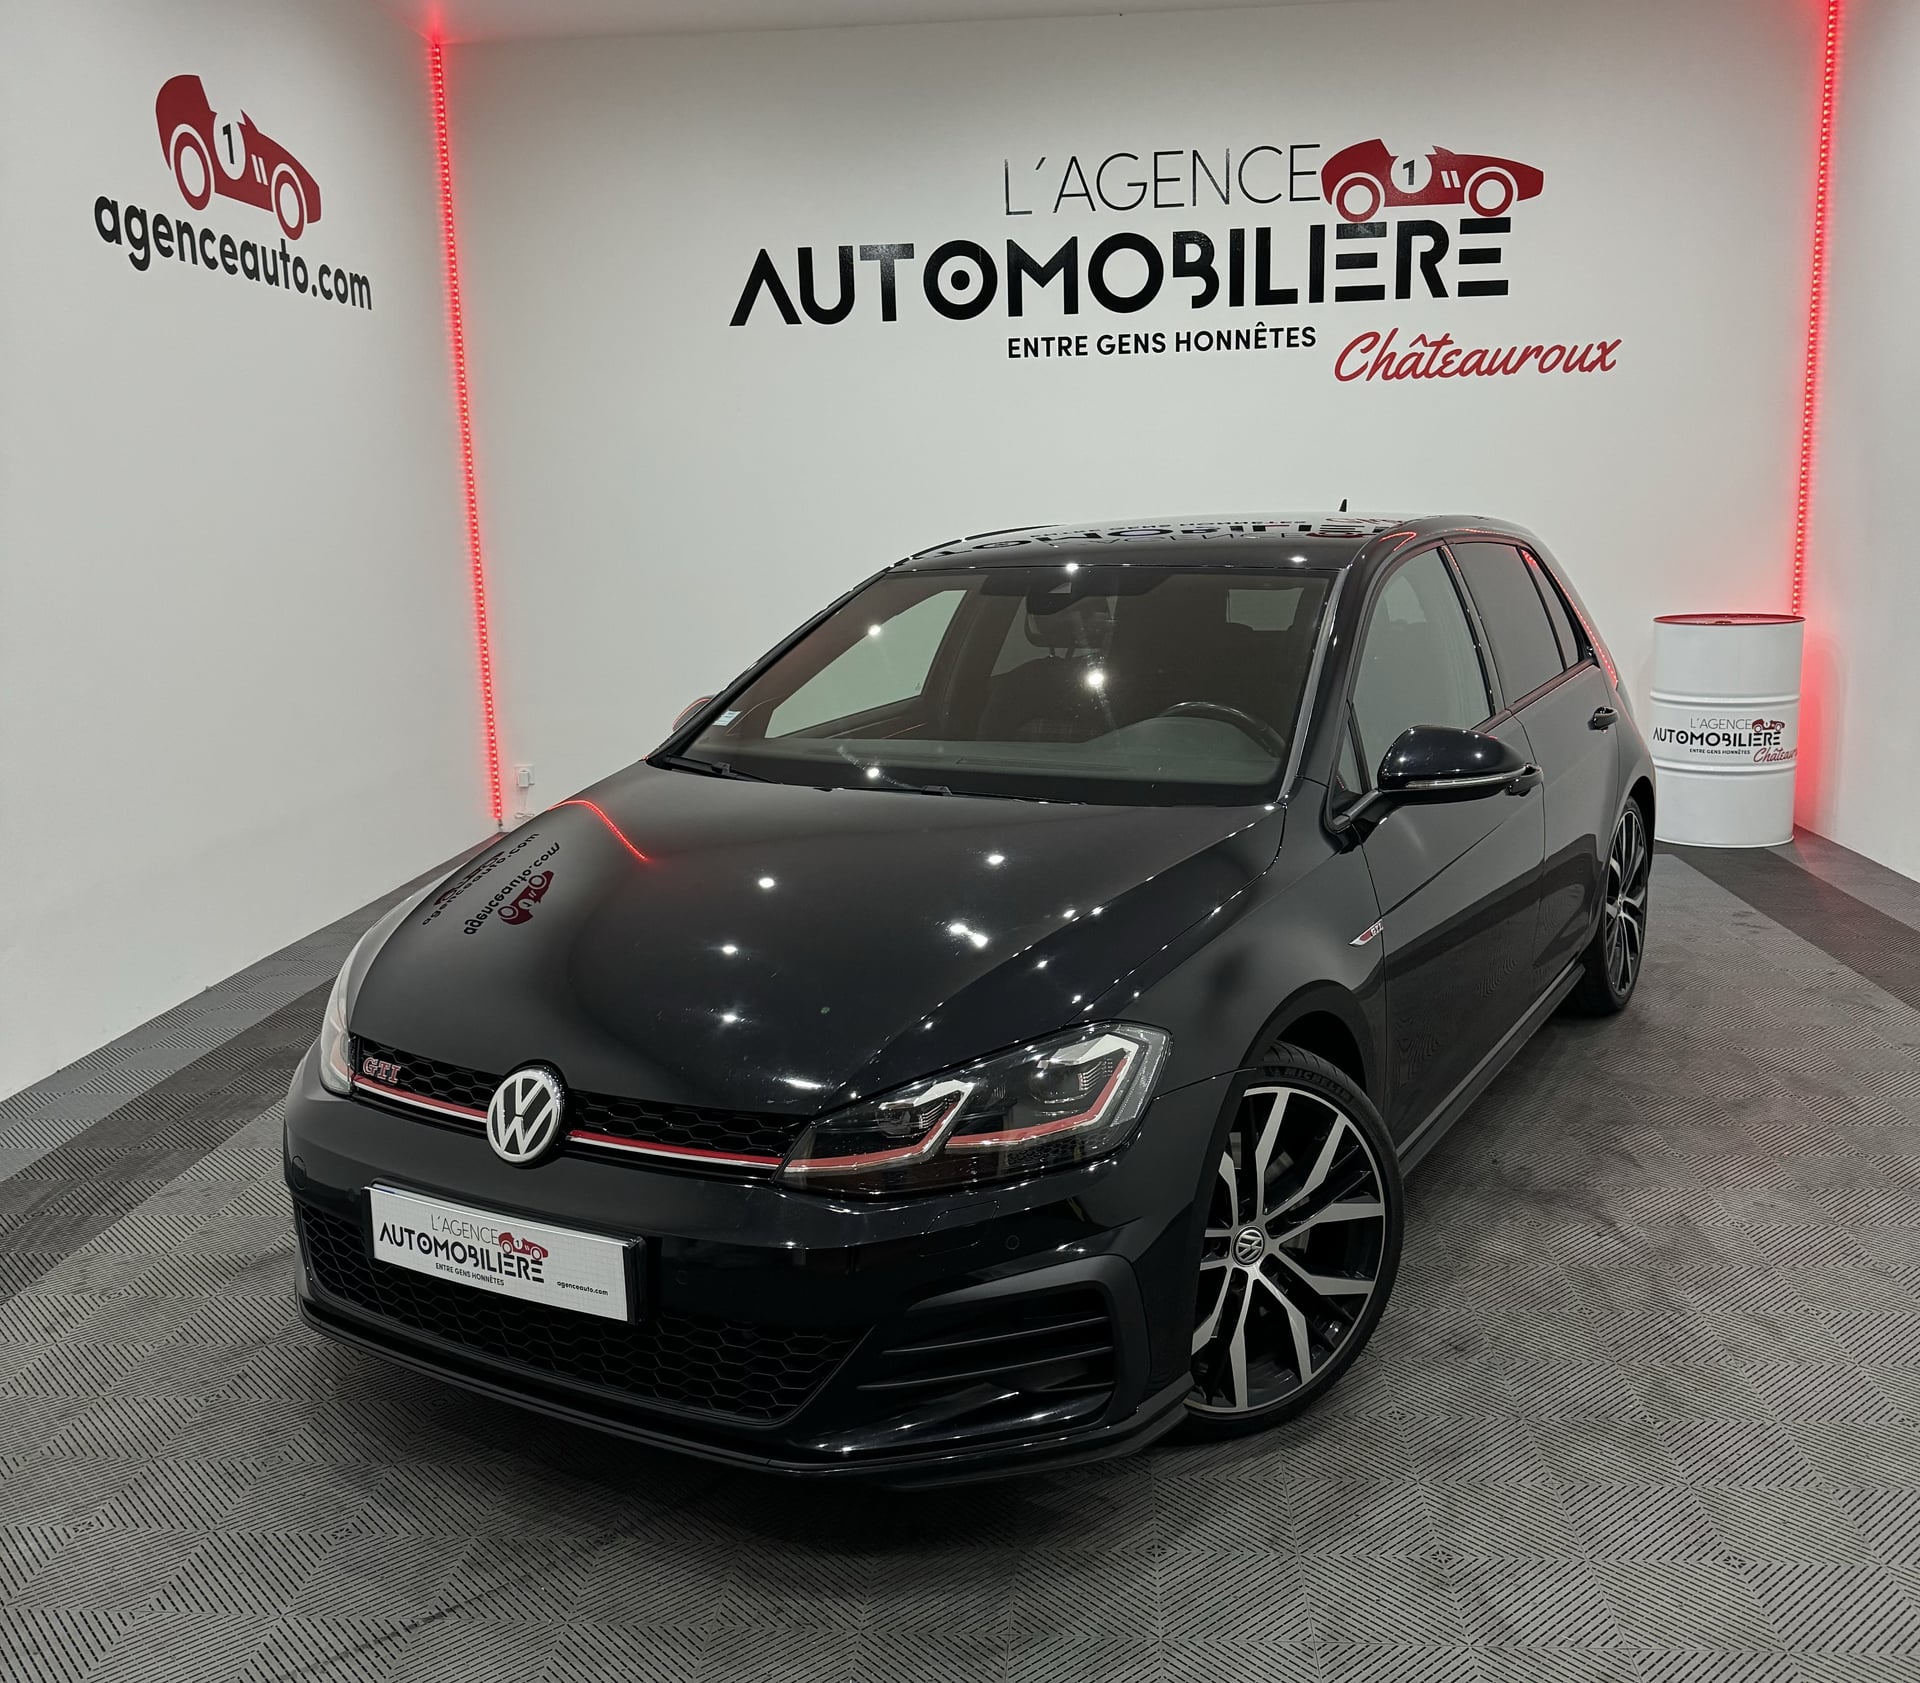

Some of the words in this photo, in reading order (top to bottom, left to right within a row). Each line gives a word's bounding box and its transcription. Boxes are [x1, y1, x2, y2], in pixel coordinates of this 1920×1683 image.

[1004, 143, 1321, 216] L'AGENCE
[94, 195, 373, 311] agenceauto.com
[729, 217, 1512, 327] AUTOMOBILIERE
[1008, 336, 1089, 358] ENTRE
[1096, 333, 1166, 356] GENS
[1175, 322, 1317, 352] HONNÊTES
[1334, 328, 1622, 382] Châteauroux
[1690, 717, 1753, 730] L'AGENCE
[362, 1056, 402, 1084] GTI
[430, 1213, 500, 1247] L'AGENCE
[379, 1221, 545, 1284] AUTOMOBILIERE
[435, 1262, 454, 1274] ENTRE
[454, 1267, 471, 1278] GENS
[556, 1280, 609, 1296] agenceauto.com
